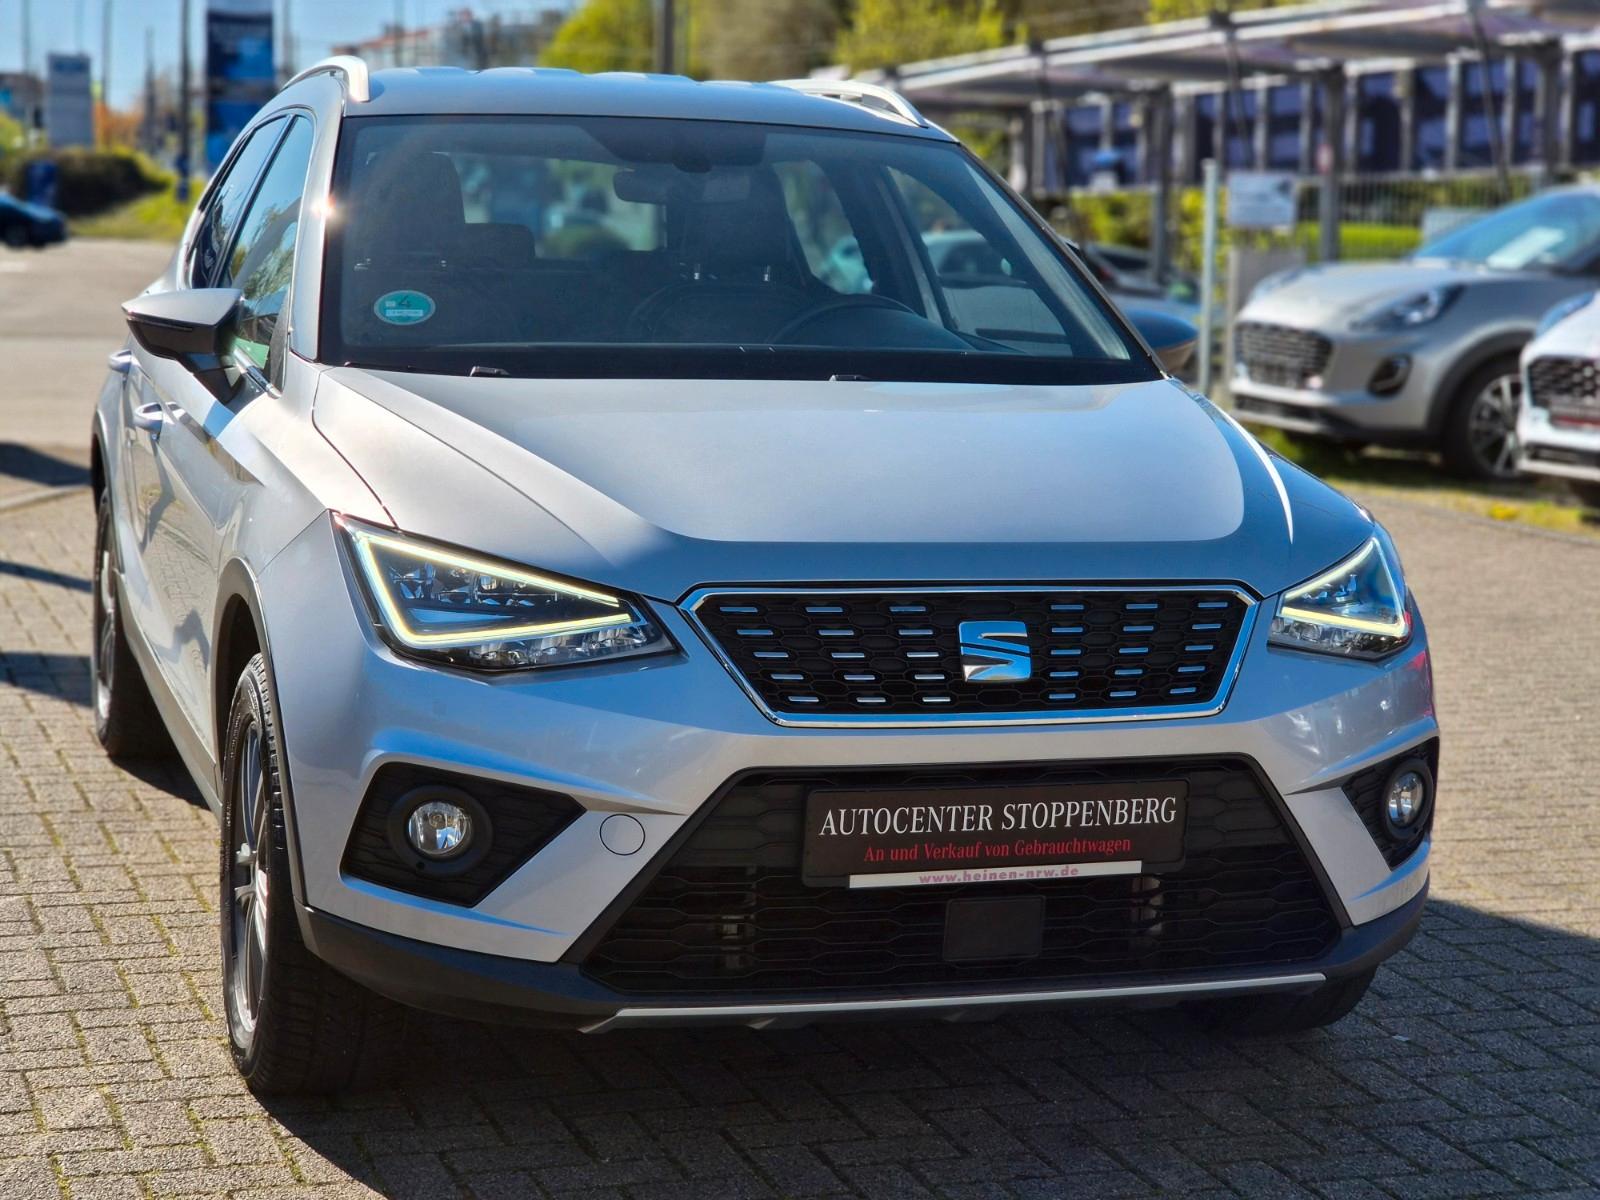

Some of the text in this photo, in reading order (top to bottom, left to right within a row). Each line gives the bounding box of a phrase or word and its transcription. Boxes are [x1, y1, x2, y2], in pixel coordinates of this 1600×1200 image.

[398, 295, 412, 307] 4
[818, 796, 1177, 836] AUTOCENTER STOPPENBERG
[864, 838, 1132, 862] An und Verkauf von Gebrauchtwagen
[919, 866, 1079, 884] www.heinen-nrw.de
